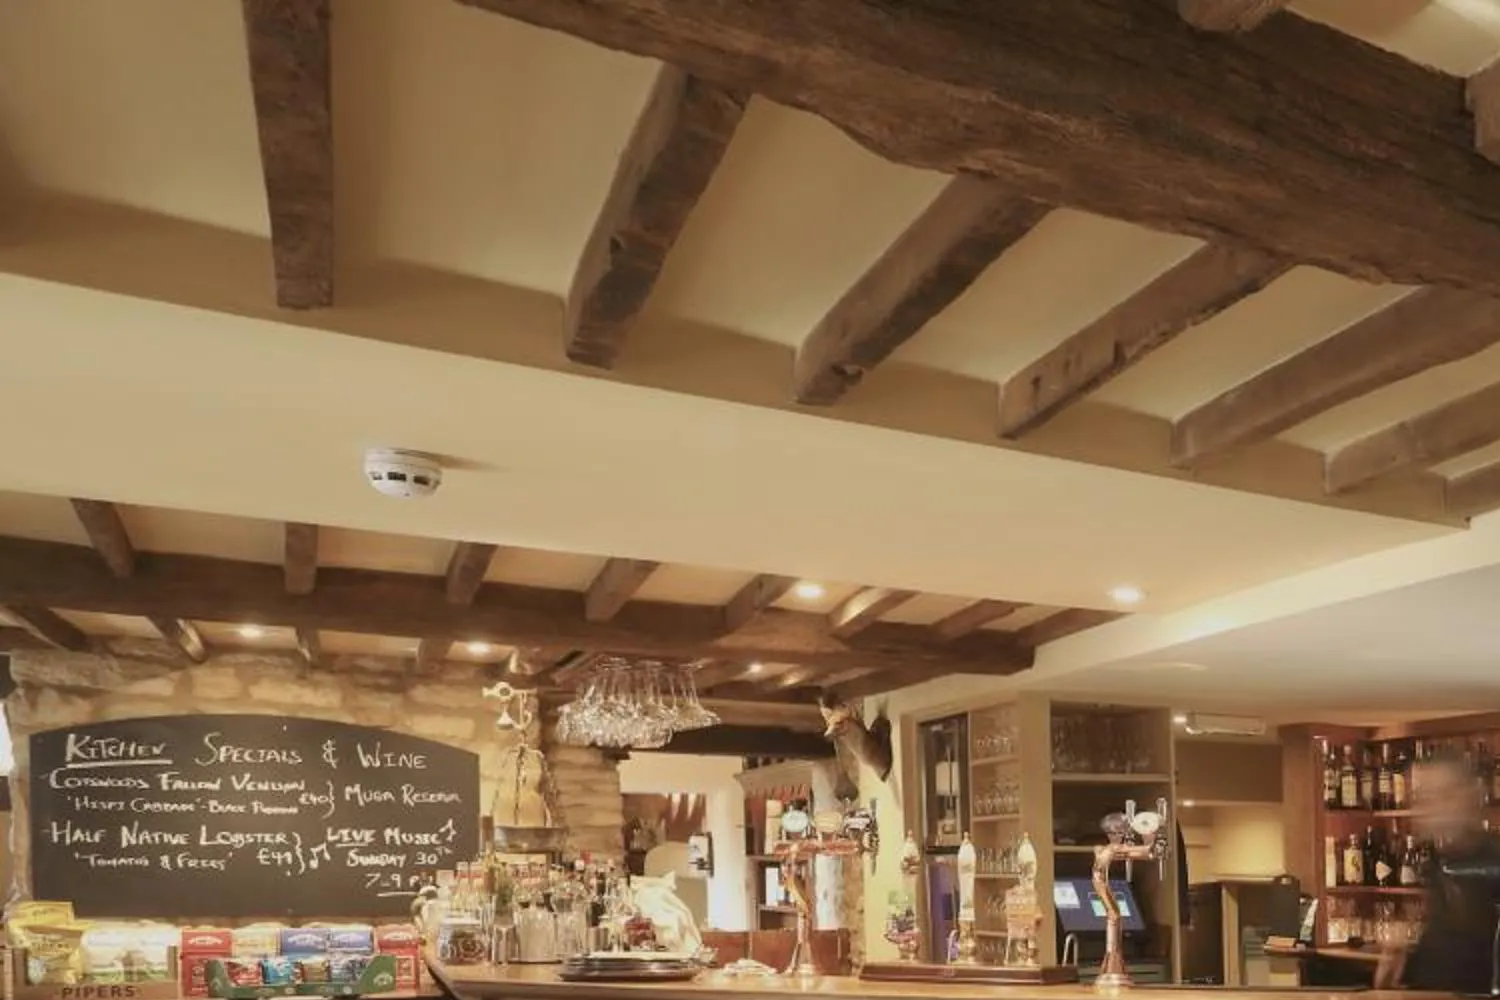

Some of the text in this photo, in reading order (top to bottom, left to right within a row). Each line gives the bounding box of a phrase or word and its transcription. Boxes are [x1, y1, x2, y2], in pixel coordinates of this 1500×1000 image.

[193, 731, 303, 767] SPECIALS
[356, 741, 428, 769] WINE
[51, 819, 289, 849] HALF NATIVE LOBSTER
[326, 826, 377, 844] LIVE
[61, 984, 137, 1000] PIPERS
